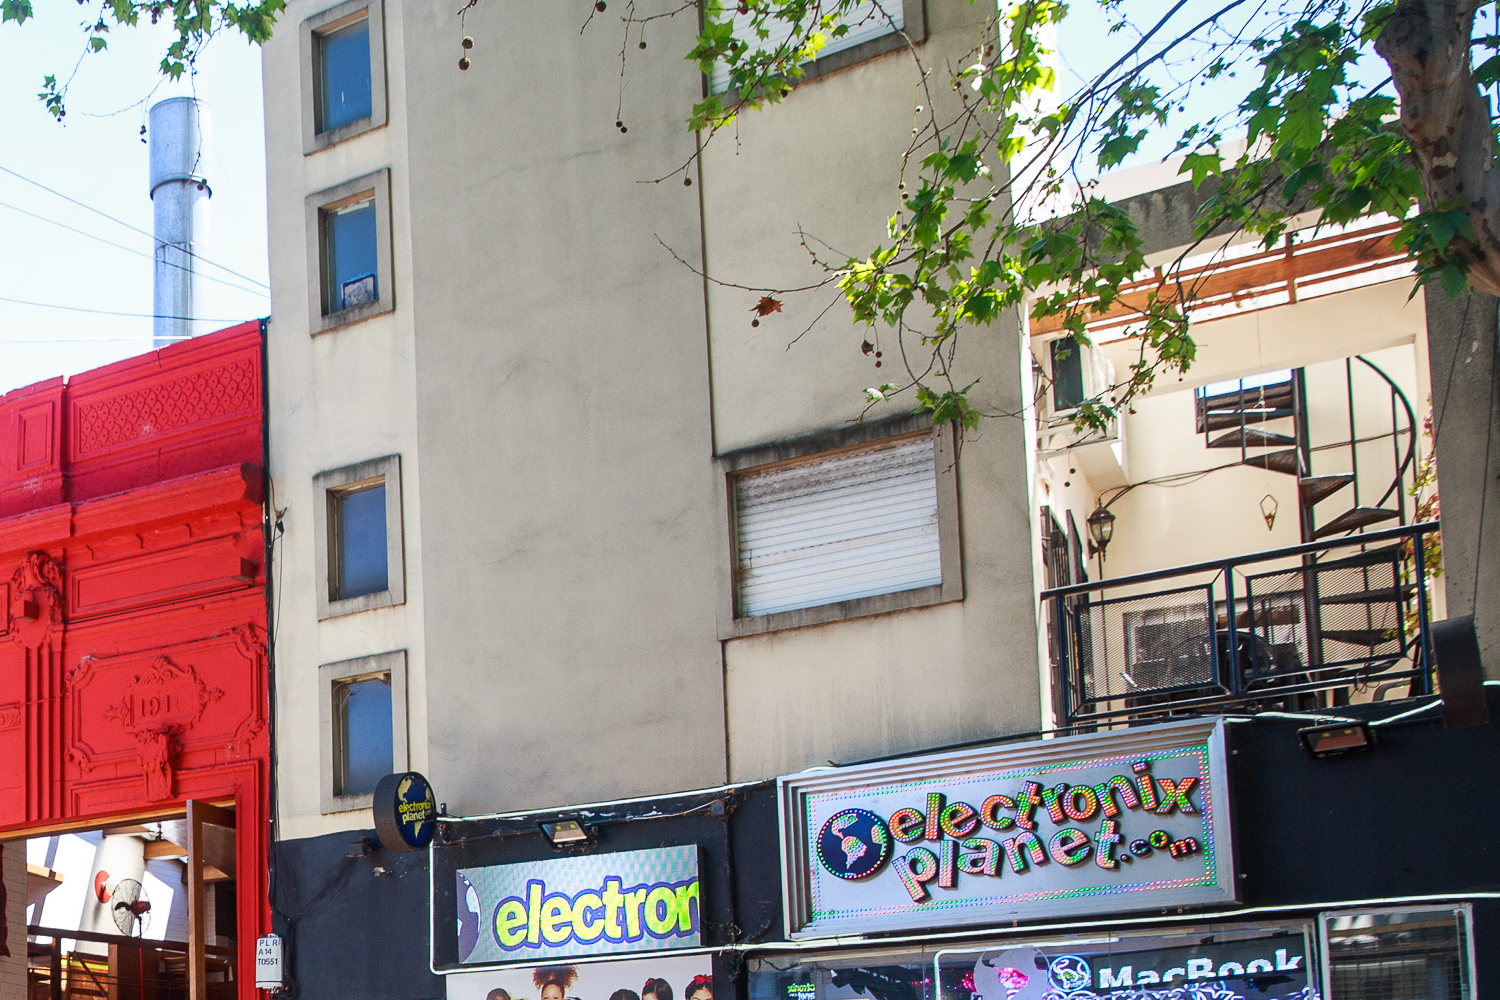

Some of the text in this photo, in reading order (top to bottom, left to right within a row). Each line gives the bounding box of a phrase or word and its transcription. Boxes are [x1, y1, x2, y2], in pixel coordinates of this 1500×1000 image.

[398, 799, 431, 813] electronix
[402, 810, 425, 825] planet
[888, 763, 1197, 843] electronix
[495, 880, 699, 947] electron
